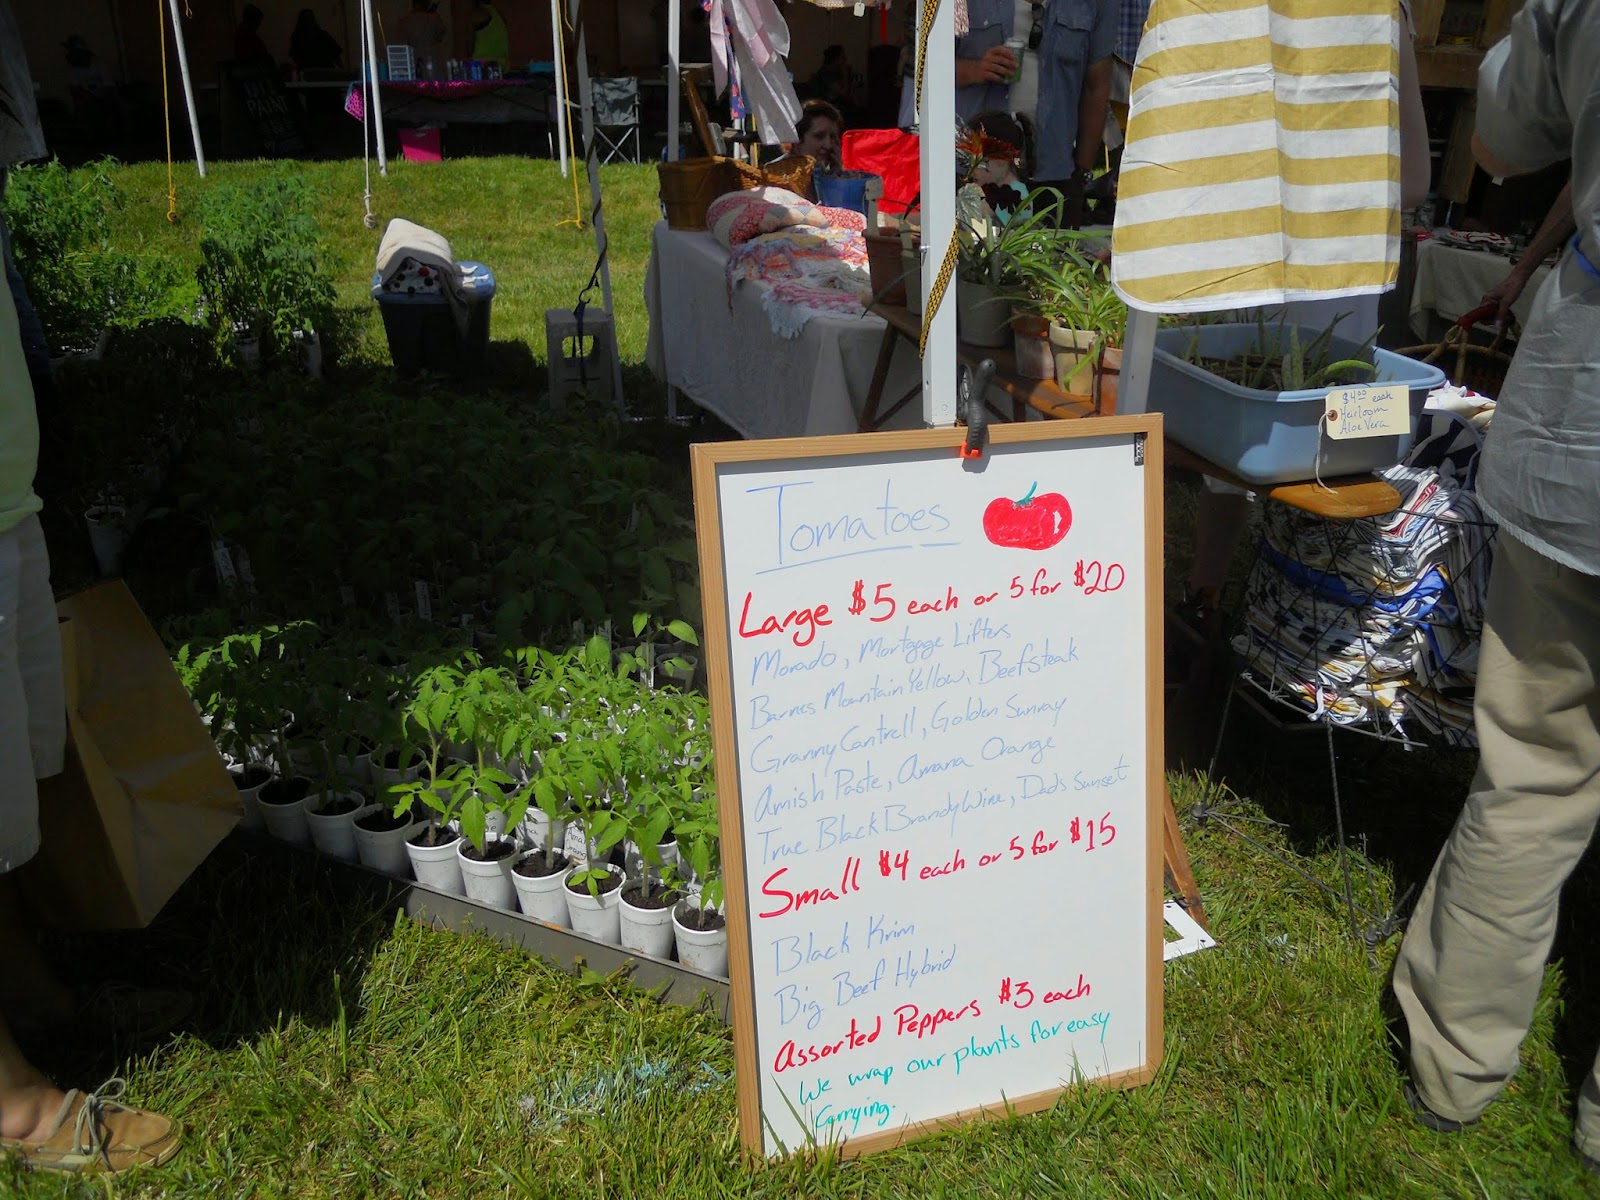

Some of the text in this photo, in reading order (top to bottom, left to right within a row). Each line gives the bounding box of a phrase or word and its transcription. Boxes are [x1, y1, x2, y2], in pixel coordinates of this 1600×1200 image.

[1340, 405, 1388, 420] Heirloom
[1340, 416, 1389, 434] Aloe Vera
[1372, 391, 1393, 402] each
[746, 479, 950, 564] Tomatoes
[739, 560, 1125, 646] Large $5 each or 5 for $20
[859, 625, 944, 664] Mortgage
[954, 618, 1011, 648] Lifters
[979, 637, 1079, 684] Beefsteak
[750, 735, 835, 775] Granny
[931, 698, 998, 732] Golden
[981, 735, 1056, 763] Orange
[757, 829, 809, 865] True
[816, 812, 878, 852] Black
[1074, 754, 1131, 791] Sunset
[759, 812, 1117, 918] Small $4 each or 5 for $15
[771, 915, 915, 976] Black Krim
[774, 944, 956, 1029] Big Beef Hybrid
[894, 1000, 981, 1039] Peppers
[998, 977, 1034, 1008] $3
[1043, 974, 1091, 1005] each
[799, 1010, 1111, 1105] We wrap our plants for easy
